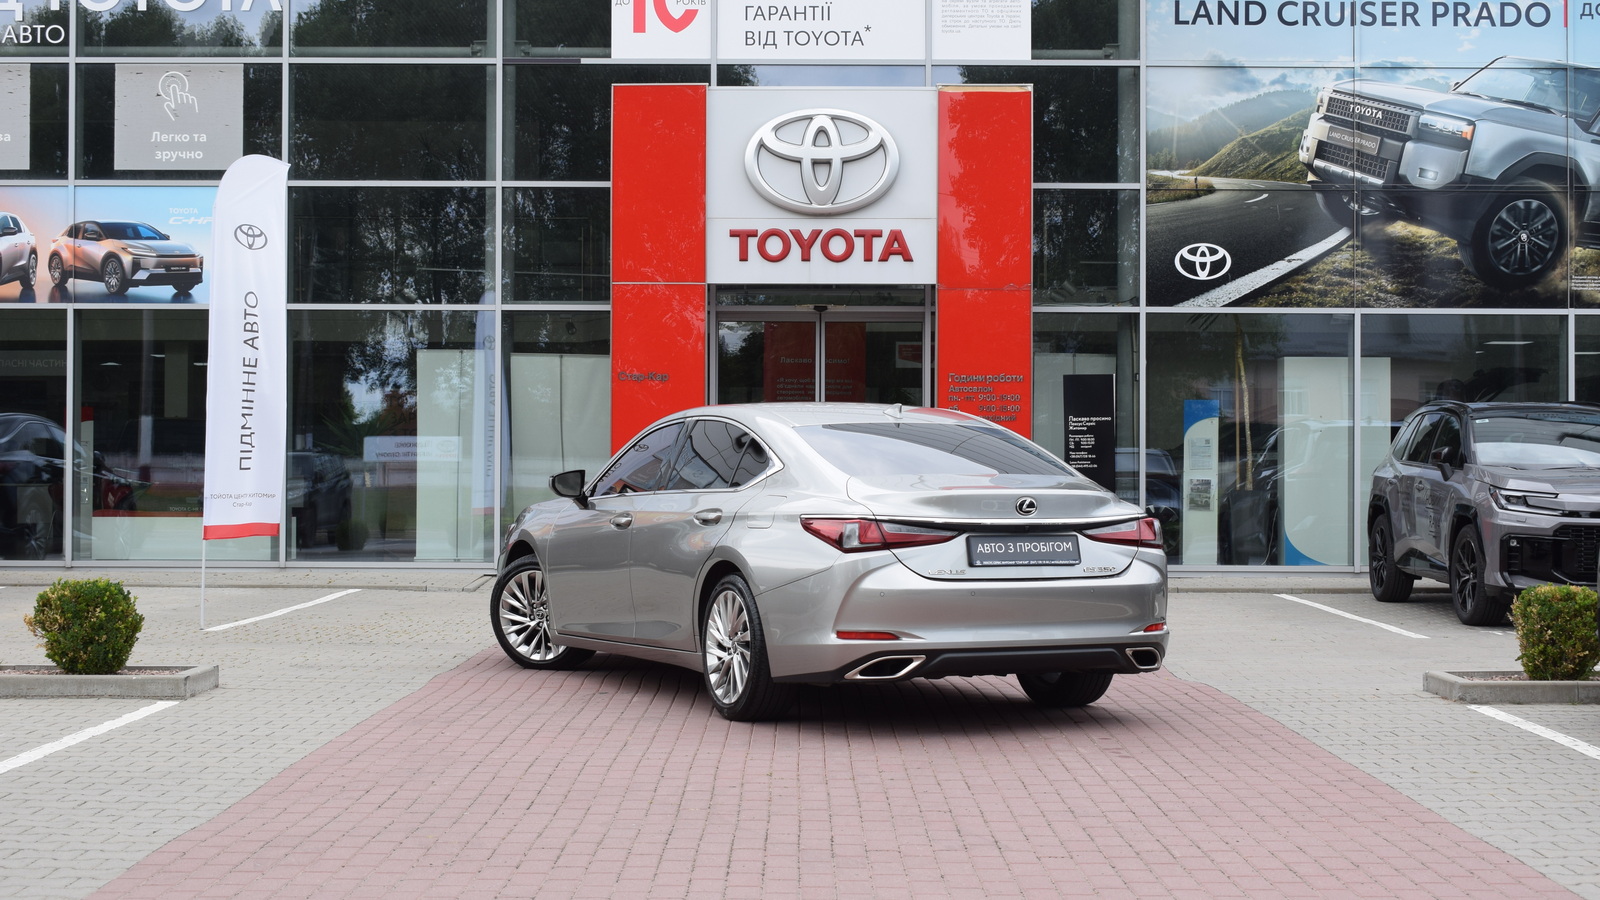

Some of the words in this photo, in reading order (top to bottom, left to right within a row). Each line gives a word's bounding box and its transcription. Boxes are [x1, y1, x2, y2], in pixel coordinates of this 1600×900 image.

[744, 2, 832, 21] ГАРАНТІЇ
[1173, 1, 1267, 26] LAND
[1277, 0, 1420, 27] CRUISER
[1432, 0, 1551, 28] PRADO
[2, 25, 65, 44] АВТО
[744, 30, 777, 49] ВІД
[1349, 104, 1383, 119] TOYOTA
[151, 131, 190, 143] Легко
[193, 133, 207, 142] та
[1329, 131, 1341, 139] LAND
[1341, 134, 1360, 145] CRUISER
[1360, 139, 1376, 149] PRADO
[155, 149, 203, 162] зручно
[729, 229, 913, 262] TOYOTA
[242, 290, 259, 351] АВТО
[618, 371, 669, 382] Стар-Кар
[948, 373, 985, 383] Години
[986, 373, 1023, 384] роботи
[239, 356, 259, 471] ПІДМІННЕ
[977, 542, 1005, 553] АВТО
[1007, 542, 1014, 553] З
[1016, 541, 1073, 553] ПРОБІГОМ
